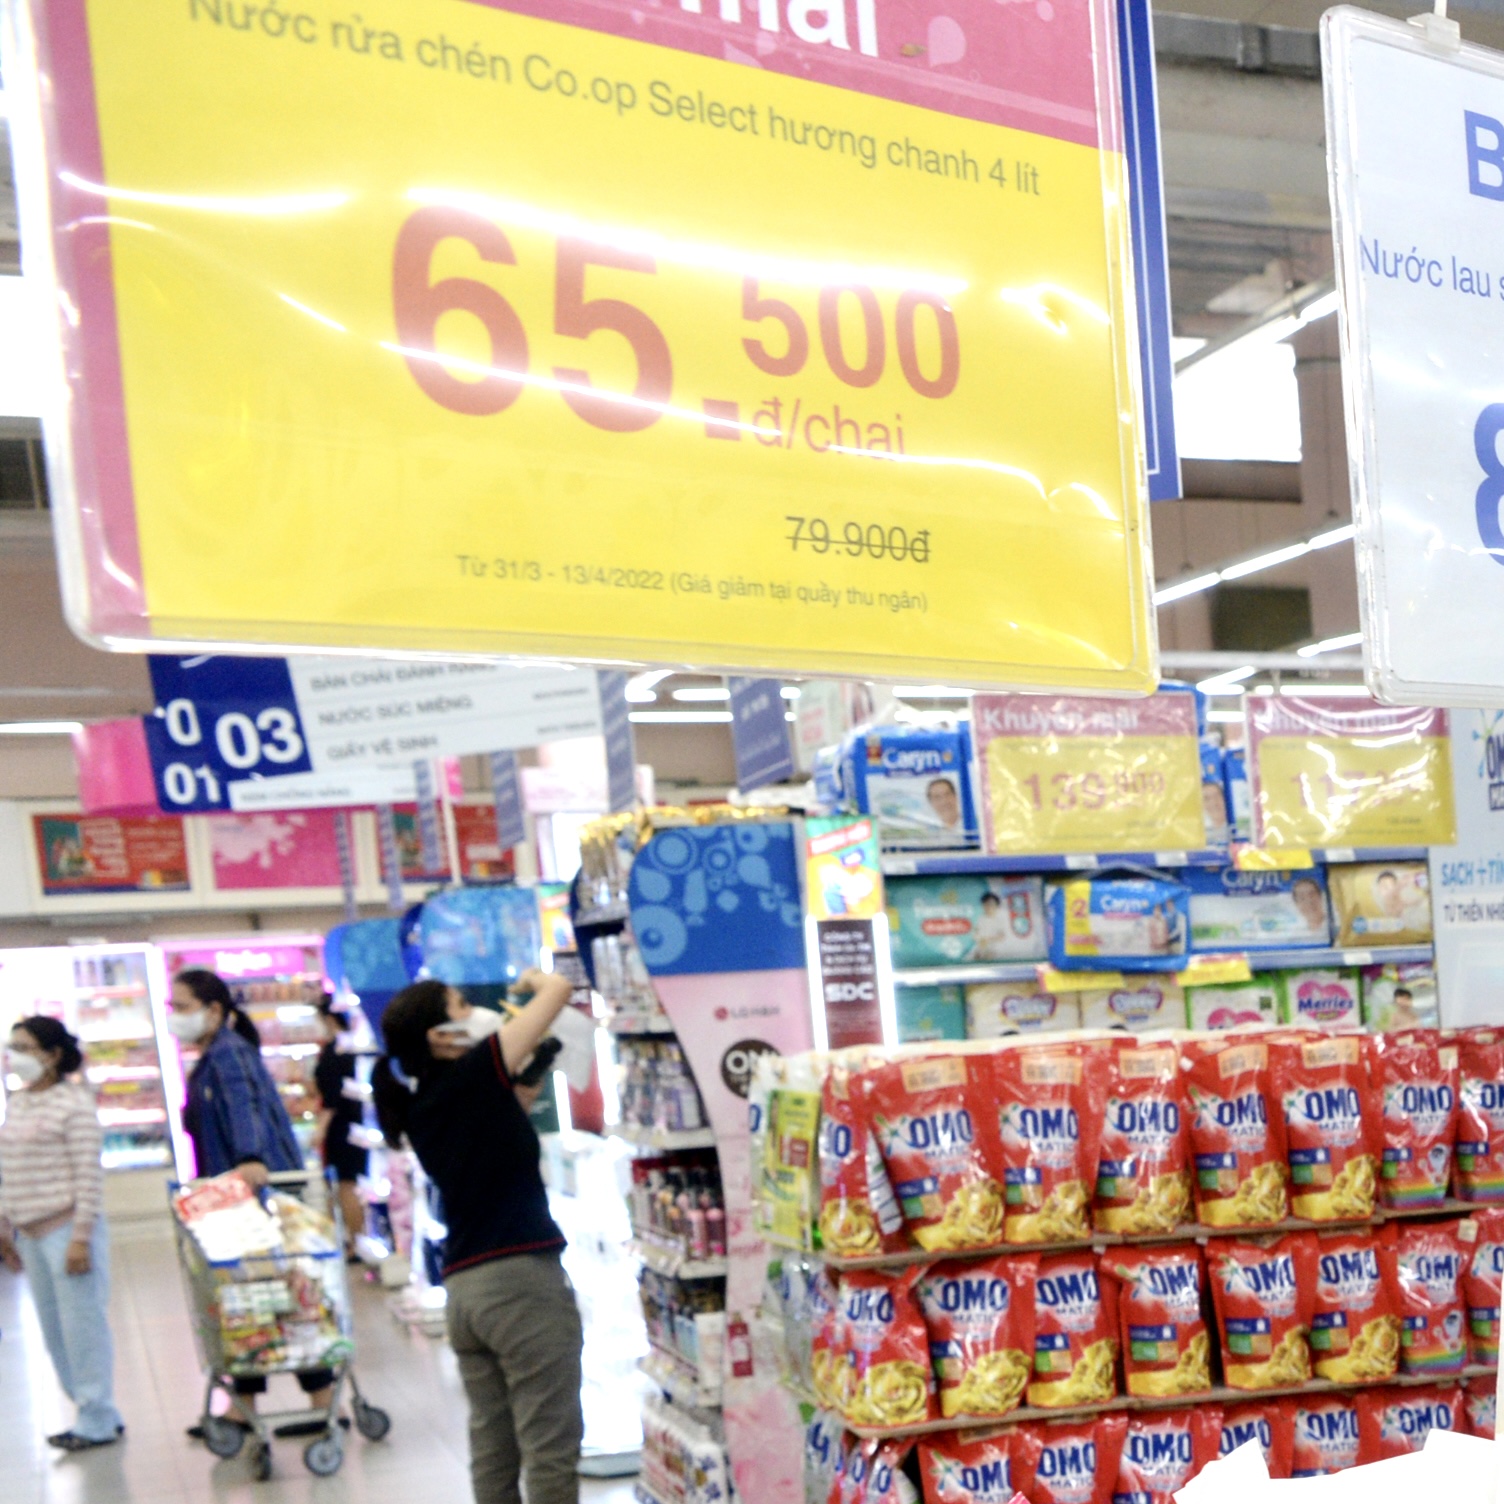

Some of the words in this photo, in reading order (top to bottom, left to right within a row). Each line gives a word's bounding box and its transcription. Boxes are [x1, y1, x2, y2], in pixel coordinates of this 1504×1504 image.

[330, 14, 404, 60] rửa
[416, 34, 512, 84] chén
[523, 54, 636, 115] Co.op
[648, 79, 759, 135] Select
[769, 107, 876, 168] hương
[887, 142, 979, 184] chanh
[989, 158, 1007, 189] 4
[1016, 161, 1040, 196] lít
[1359, 234, 1443, 289] Nước
[1451, 255, 1492, 300] lau
[740, 275, 962, 400] 500
[752, 396, 905, 461] đ/chai
[456, 555, 486, 579] Từ
[493, 557, 542, 582] 31/3
[561, 563, 664, 591] 13/4/2022
[215, 707, 303, 768] 03
[164, 763, 221, 805] 01
[1441, 860, 1474, 894] SẠCH
[1305, 1086, 1360, 1121] OMO
[1403, 1084, 1454, 1113] OMO
[1320, 1248, 1379, 1285] OMO
[940, 1278, 1009, 1312] OMO
[1130, 1432, 1192, 1464] OMO
